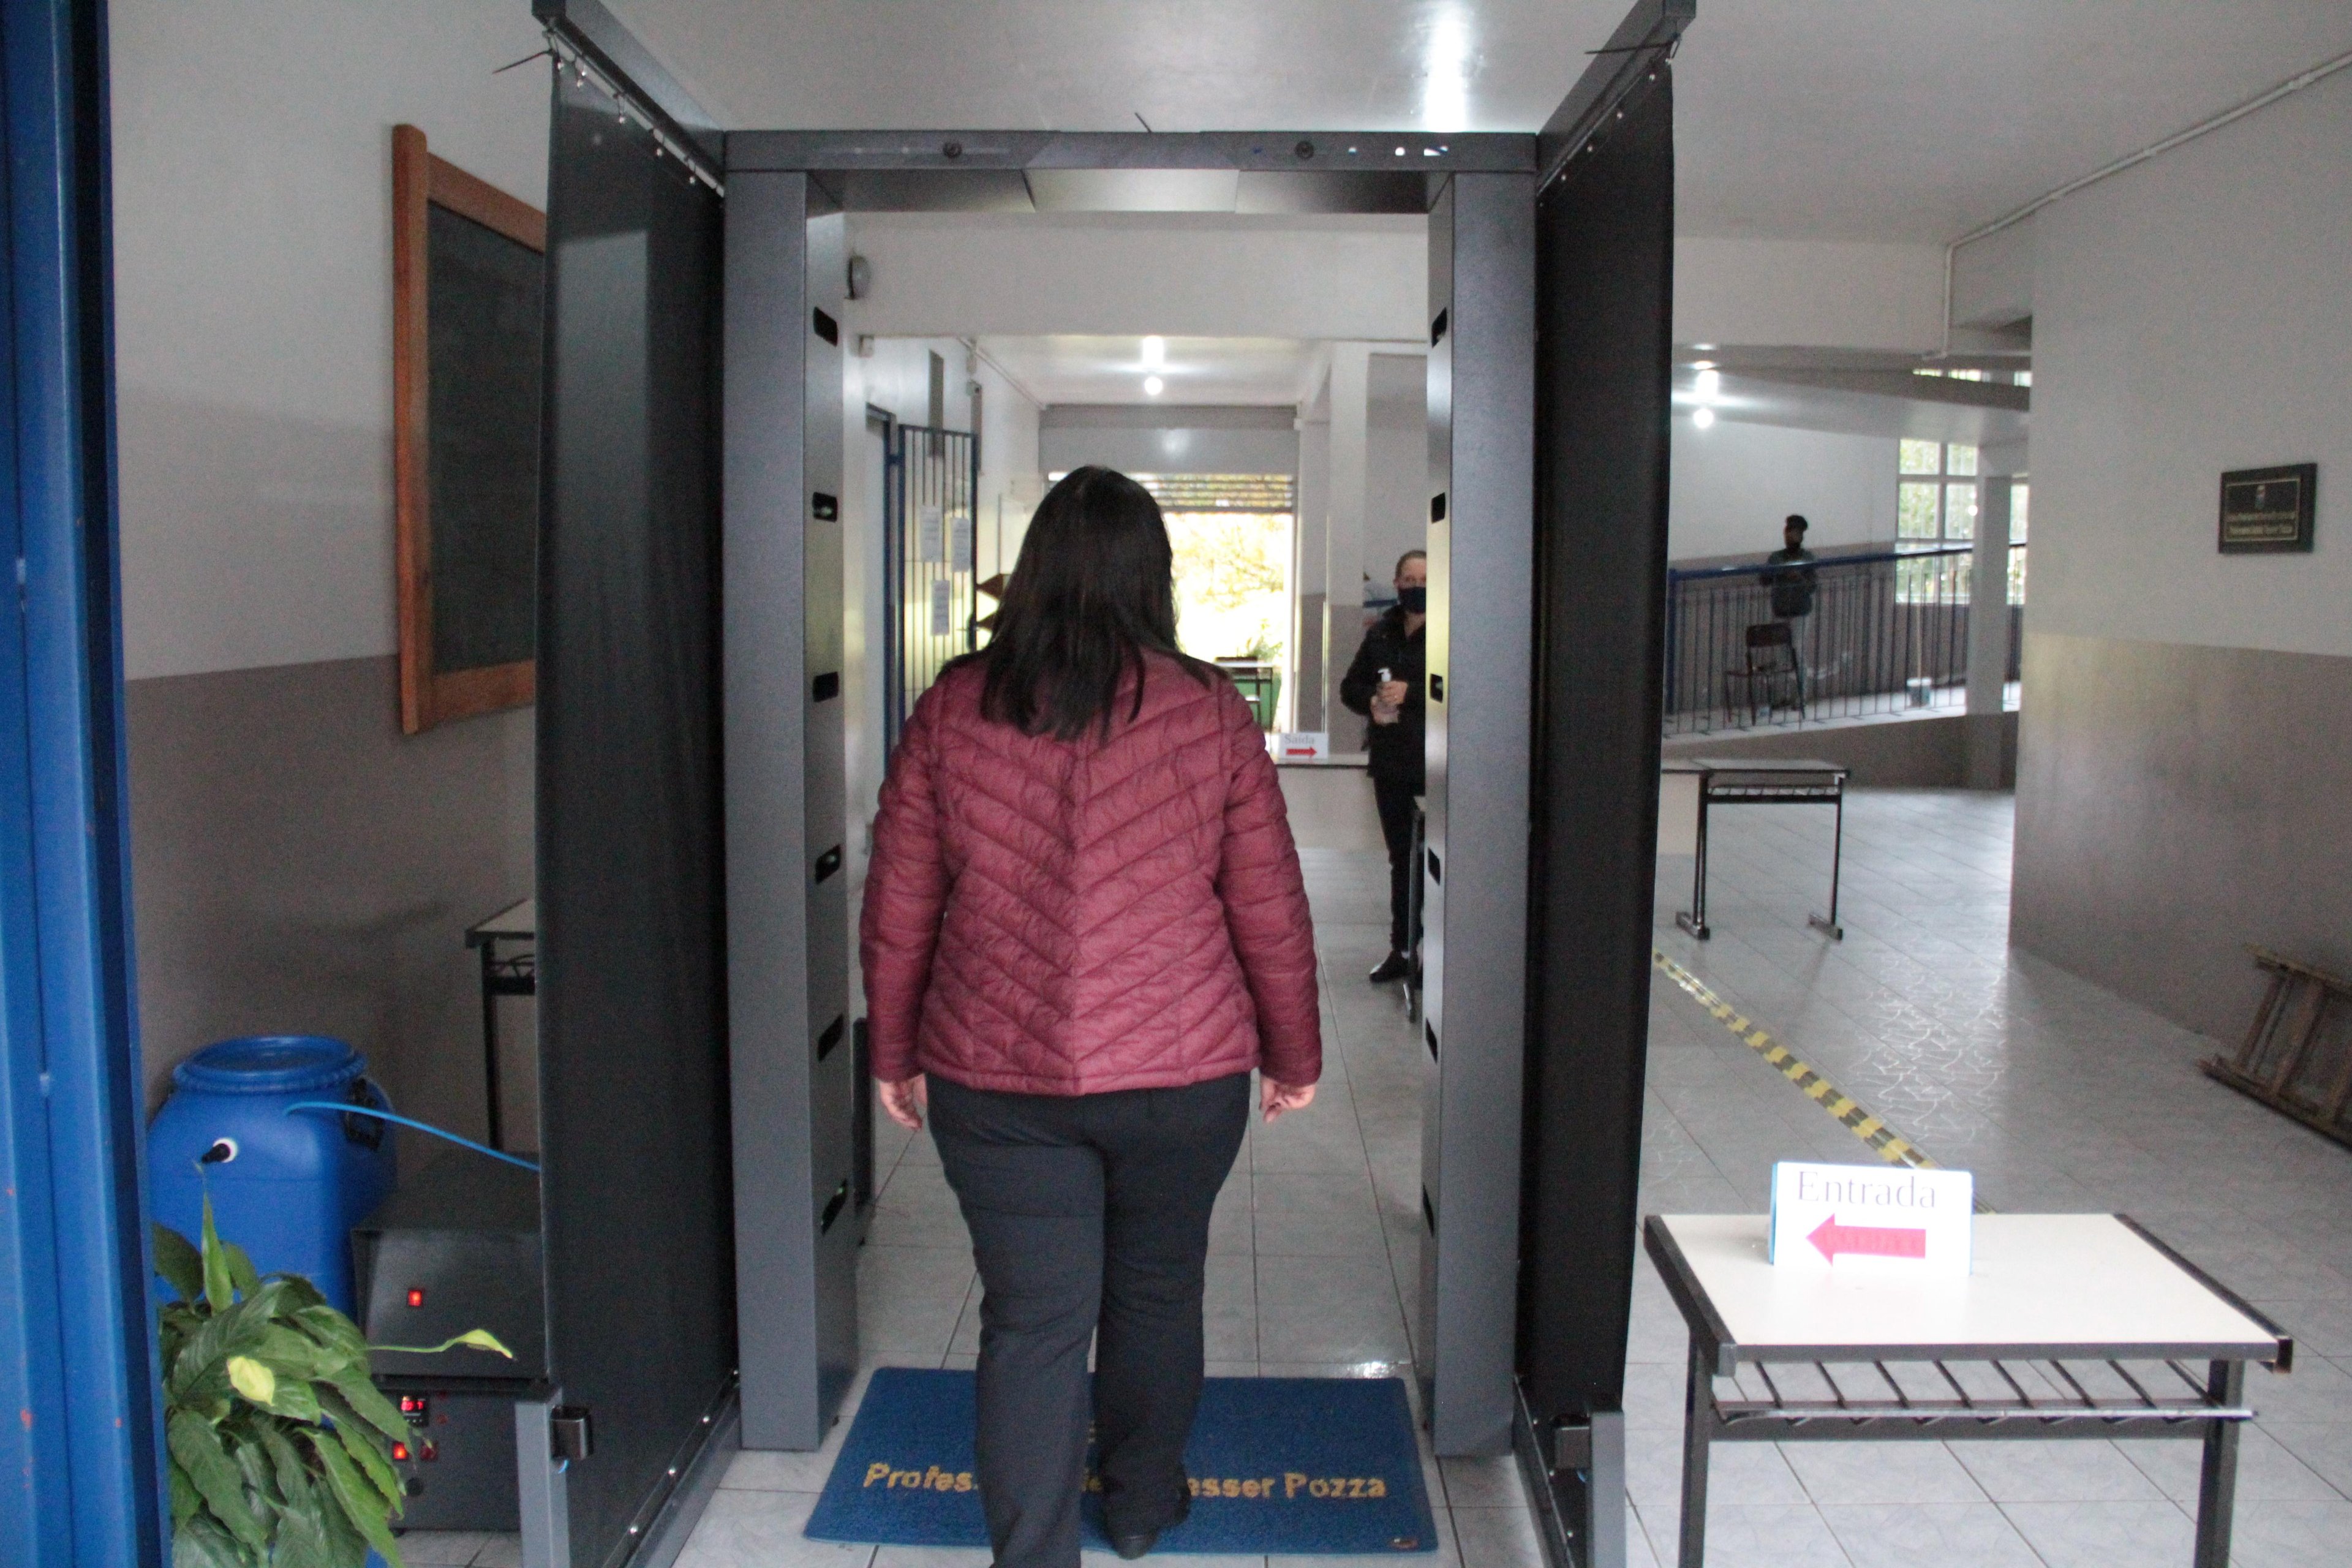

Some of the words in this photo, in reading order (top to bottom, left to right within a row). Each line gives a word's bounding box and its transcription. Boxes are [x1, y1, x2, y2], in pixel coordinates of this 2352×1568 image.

[1798, 1170, 1936, 1208] Entrada
[863, 1462, 978, 1493] Profes
[1284, 1472, 1386, 1498] Pozza
